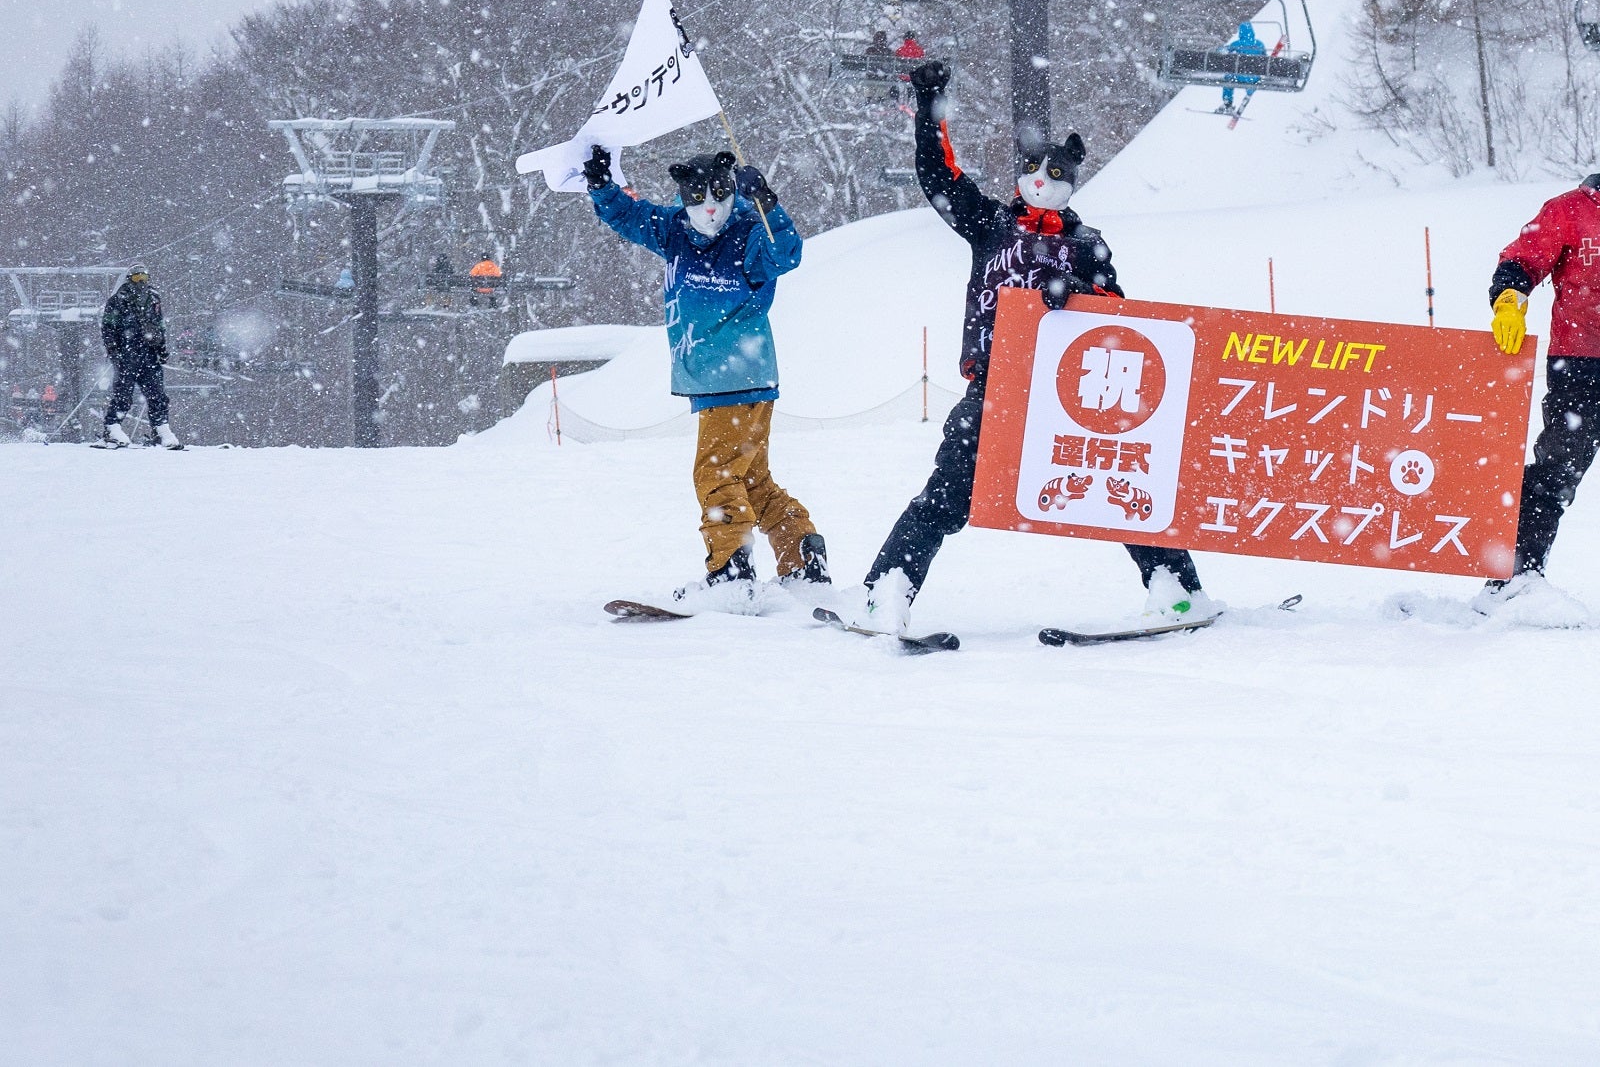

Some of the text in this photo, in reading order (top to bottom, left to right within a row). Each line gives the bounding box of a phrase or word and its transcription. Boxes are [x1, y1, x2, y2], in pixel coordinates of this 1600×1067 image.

[1077, 345, 1144, 413] 祝
[1221, 332, 1386, 373] NEW LIFT
[1218, 377, 1483, 434] フレンドリー
[1051, 434, 1152, 475] 運行式
[1210, 434, 1375, 484] キャット
[1202, 496, 1472, 557] エクスプレス
